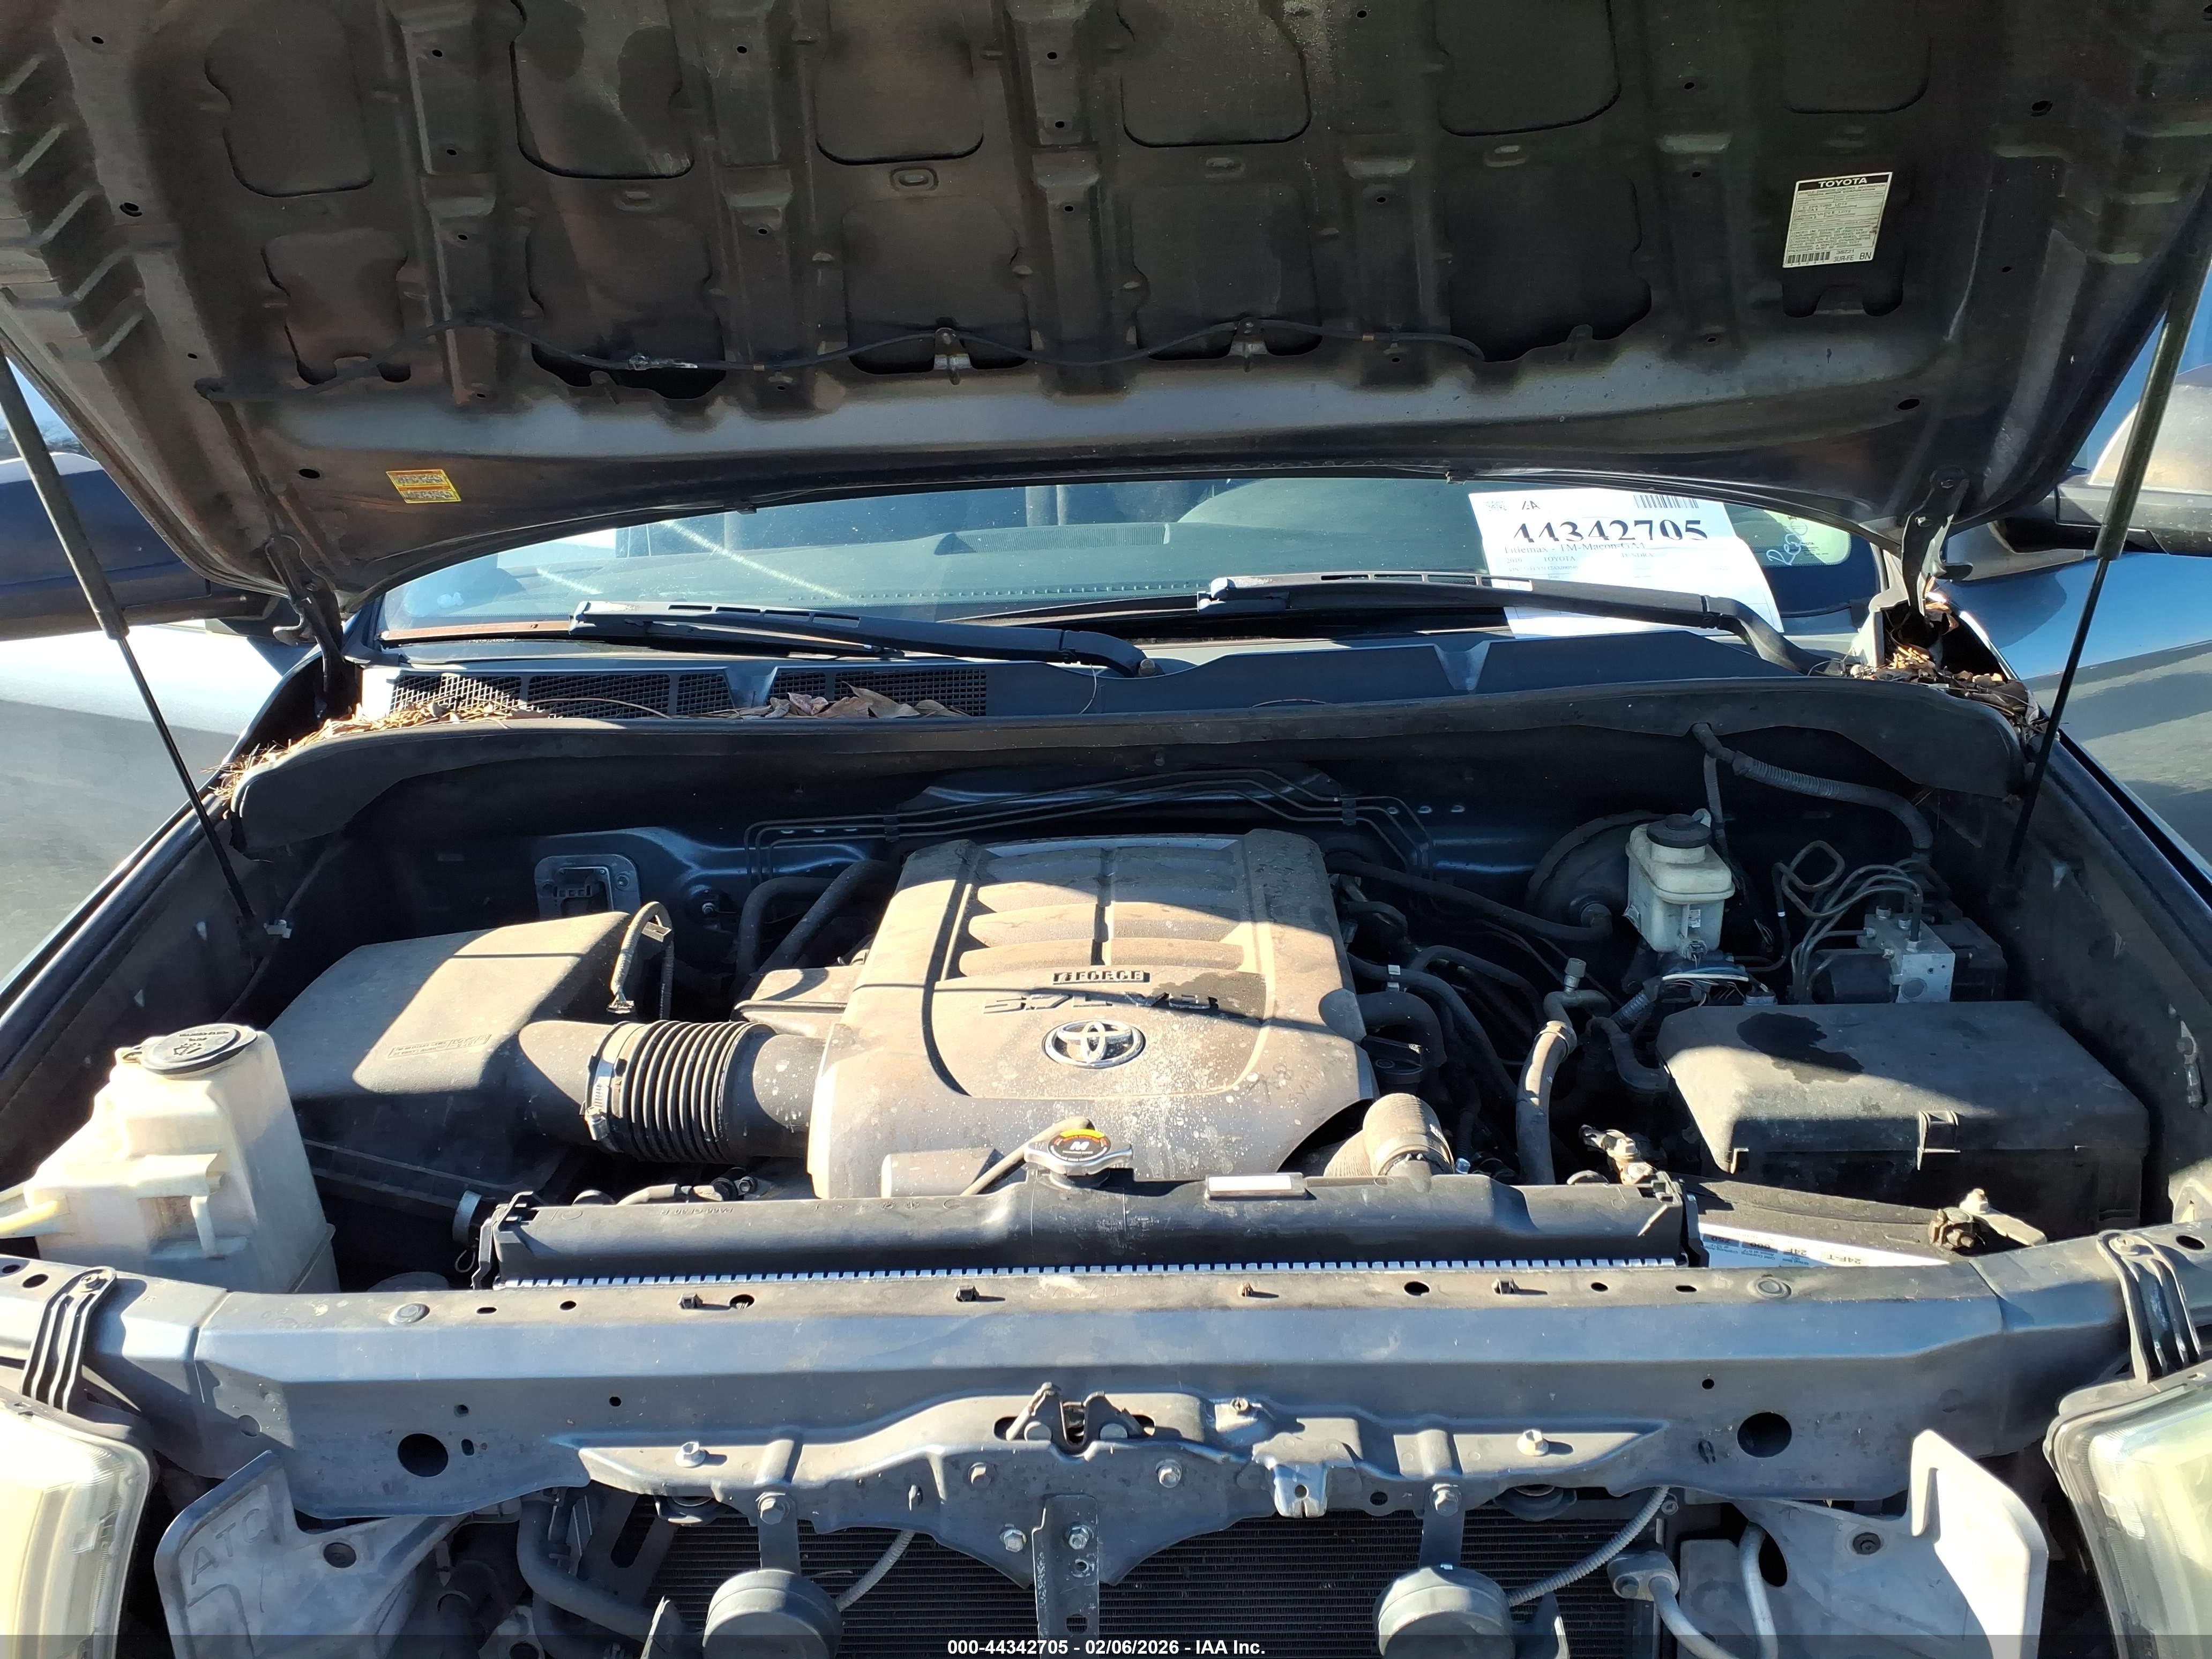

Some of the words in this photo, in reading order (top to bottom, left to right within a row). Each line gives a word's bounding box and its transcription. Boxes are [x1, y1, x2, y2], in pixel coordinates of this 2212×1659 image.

[1818, 177, 1867, 188] TOYOTA
[1513, 519, 1708, 543] 44342705
[1827, 1254, 1861, 1265] 24F-T
